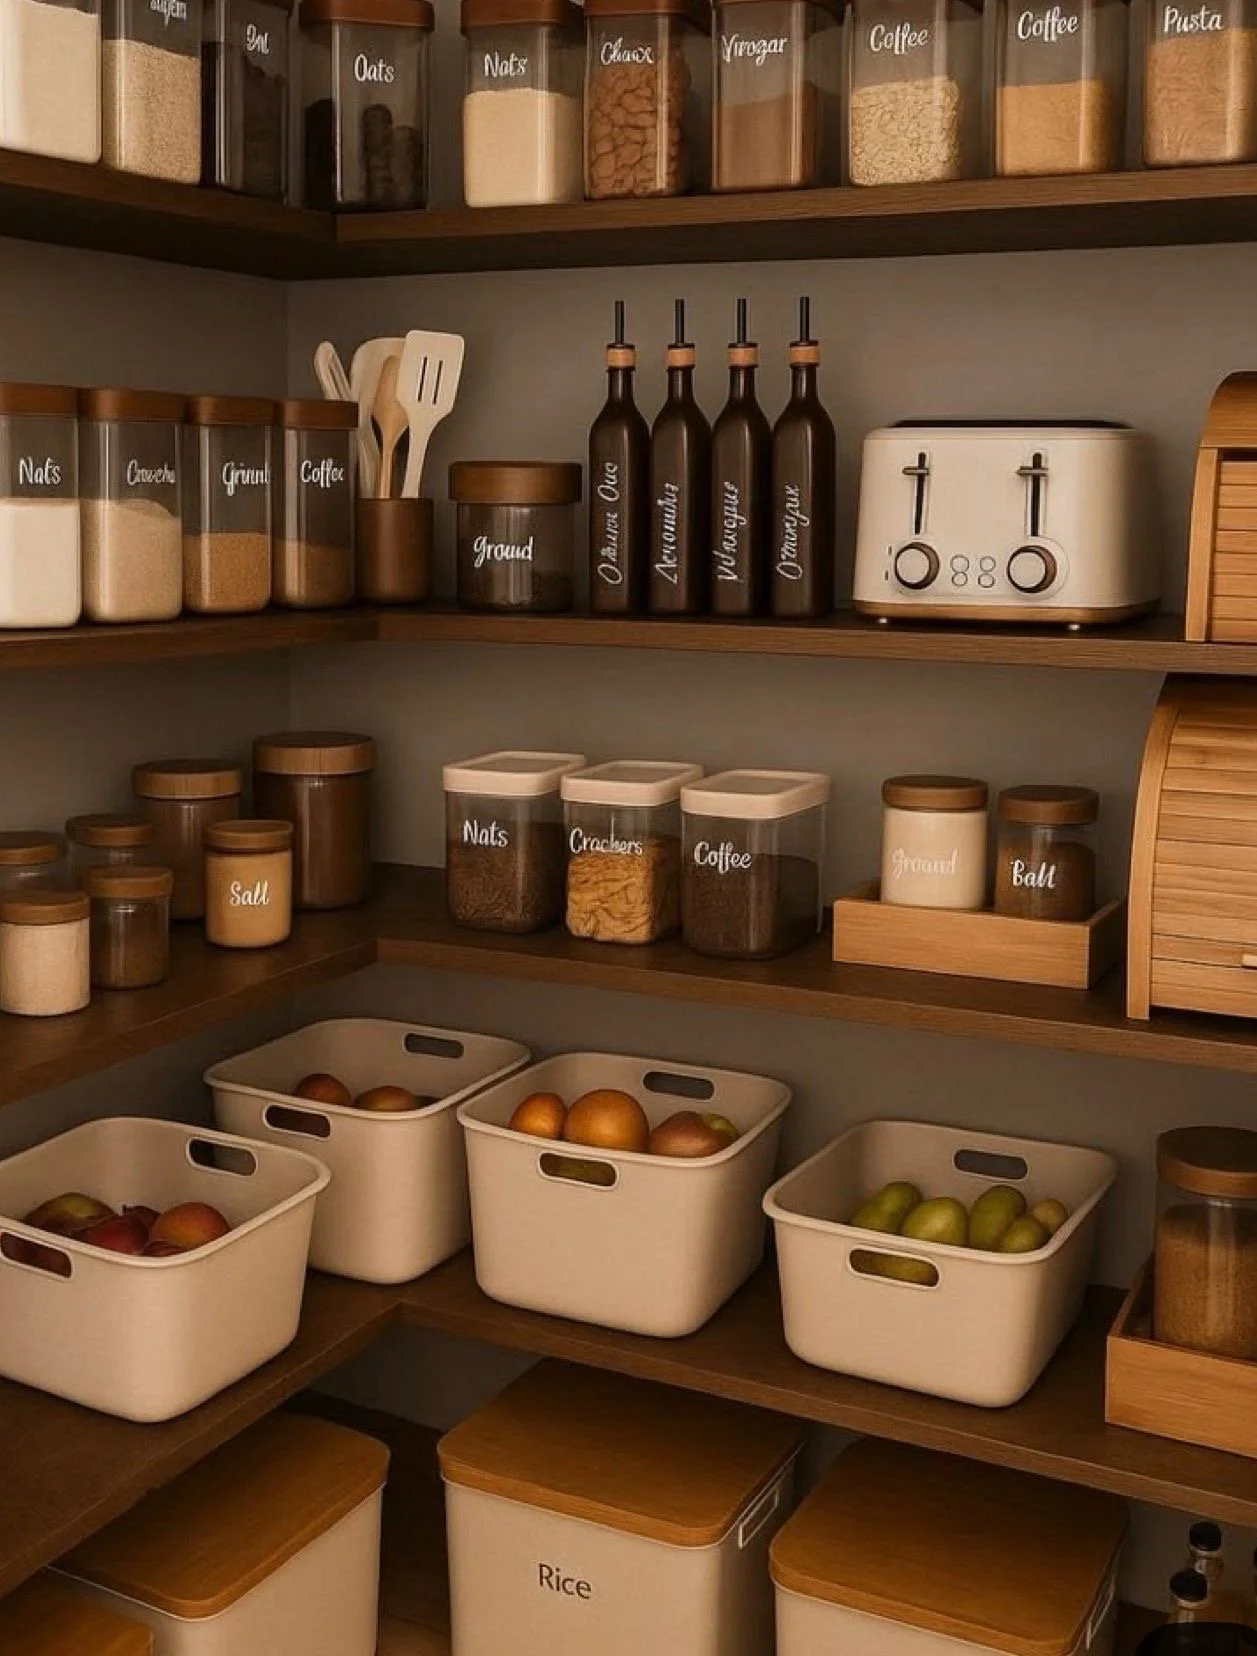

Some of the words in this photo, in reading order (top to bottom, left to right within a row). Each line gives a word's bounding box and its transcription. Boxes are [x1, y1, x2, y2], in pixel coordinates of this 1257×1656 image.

[869, 22, 930, 55] Coffee
[1017, 5, 1080, 43] Coffee
[353, 52, 395, 83] Oats
[463, 819, 510, 849] Nats
[693, 840, 754, 875] Coffee
[538, 1562, 592, 1600] Rice
